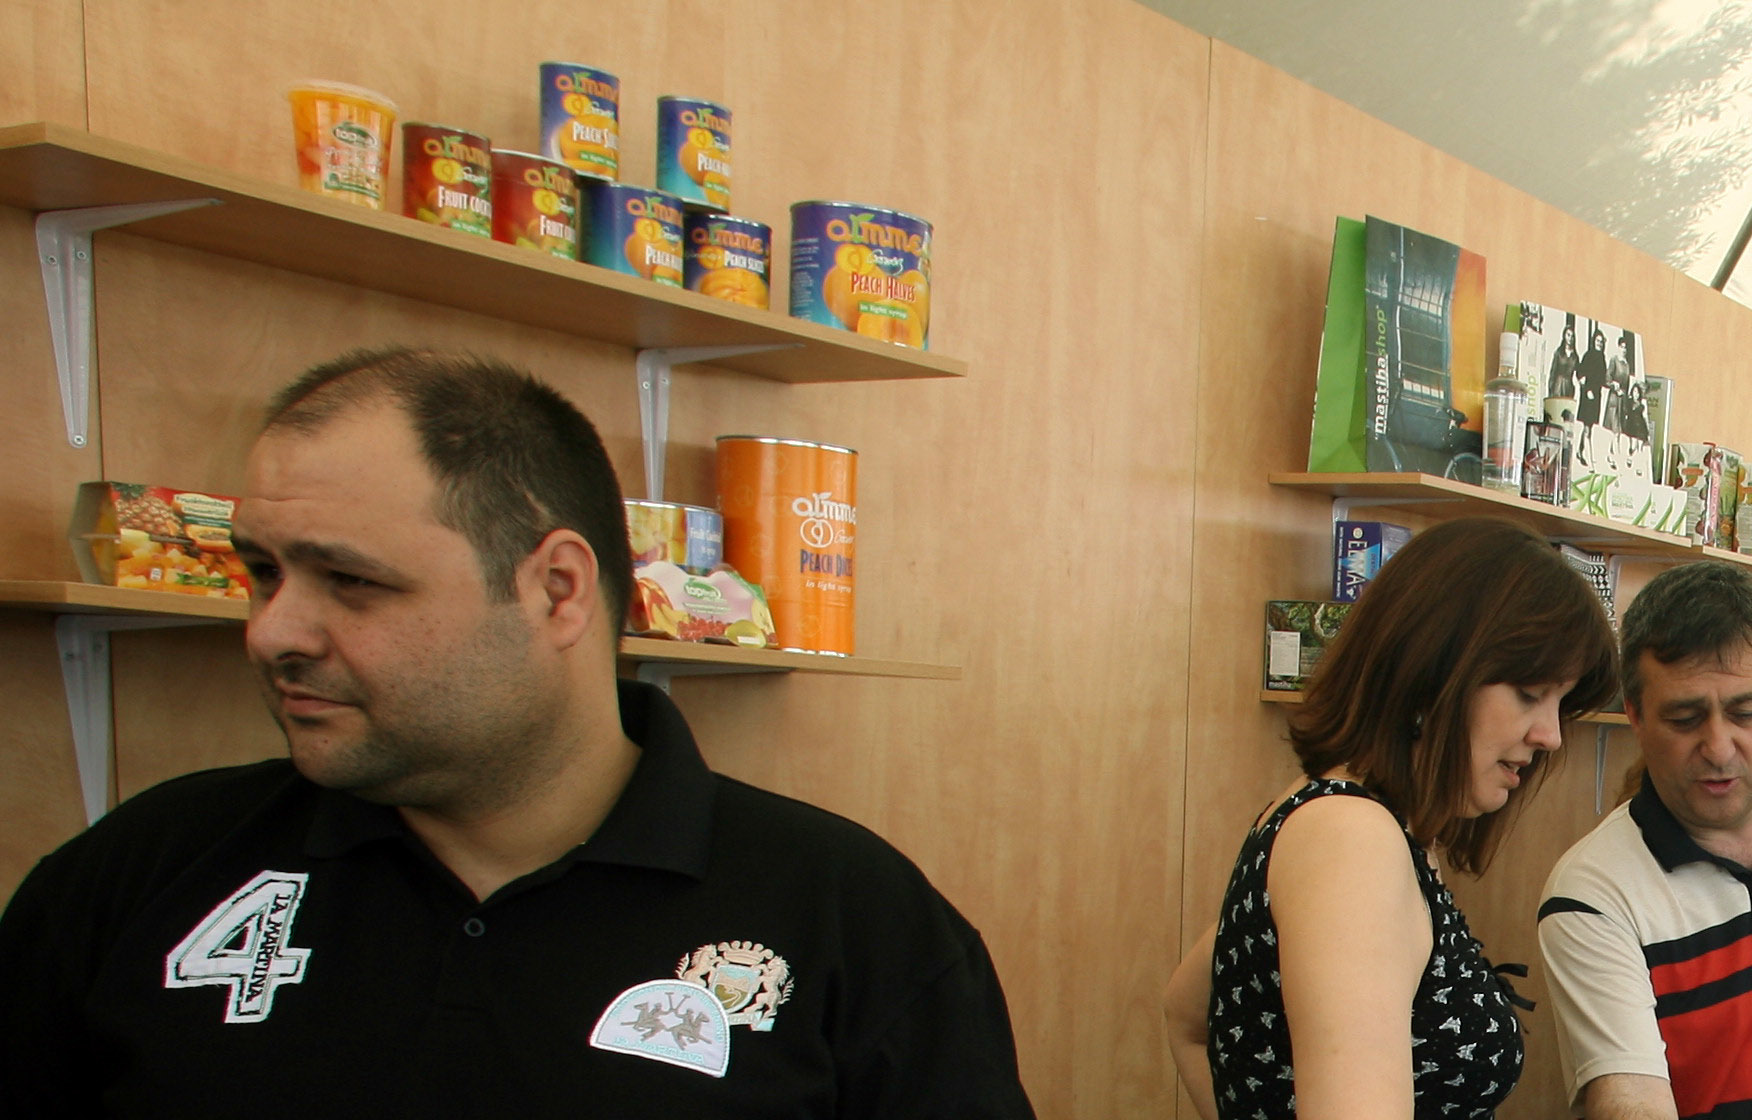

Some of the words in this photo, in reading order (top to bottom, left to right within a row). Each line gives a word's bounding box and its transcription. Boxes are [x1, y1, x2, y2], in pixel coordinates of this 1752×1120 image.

[572, 121, 602, 143] PEACH
[437, 185, 469, 210] FRUIT
[851, 272, 884, 295] PEACH
[886, 276, 917, 303] HALVES
[800, 549, 833, 574] PEACH
[1346, 540, 1368, 586] ELMA
[271, 893, 291, 915] LA
[163, 870, 312, 1024] 4
[245, 921, 284, 1003] MARTINA
